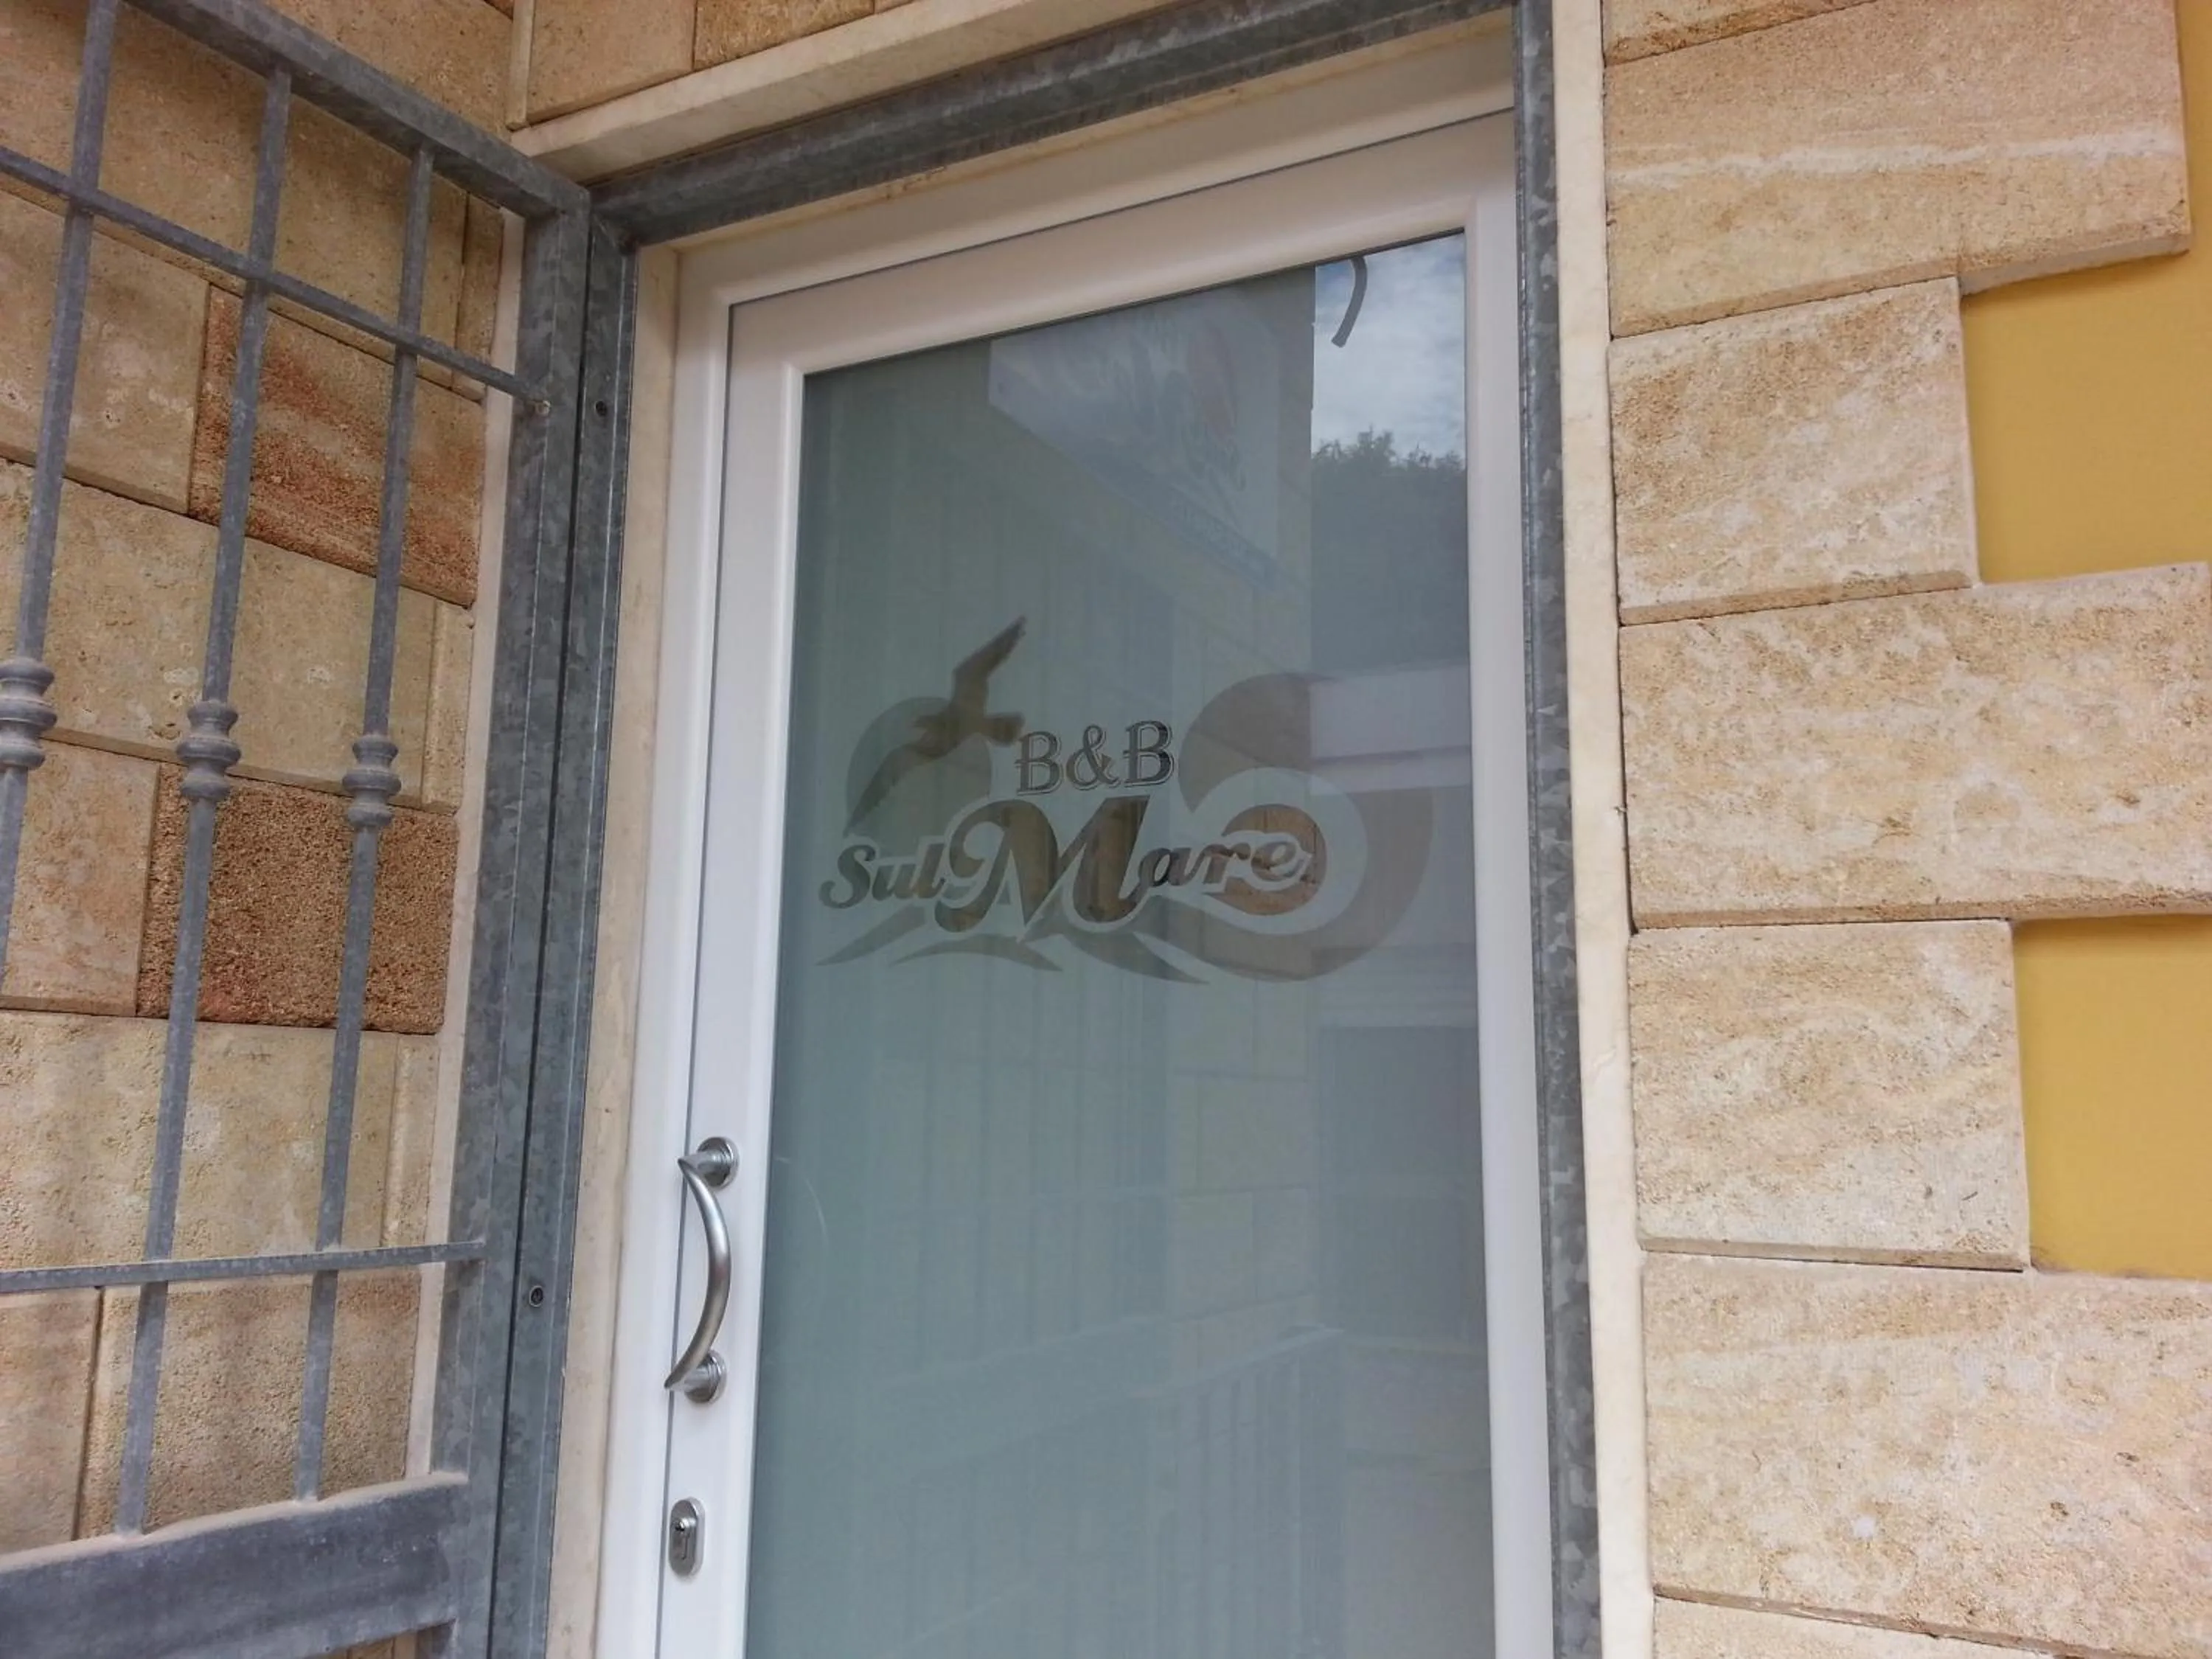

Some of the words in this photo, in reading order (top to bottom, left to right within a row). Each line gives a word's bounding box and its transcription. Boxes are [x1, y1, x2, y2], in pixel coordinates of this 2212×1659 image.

[1015, 720, 1175, 796] B&B
[820, 842, 945, 908] Sul
[935, 796, 1307, 932] Mare
